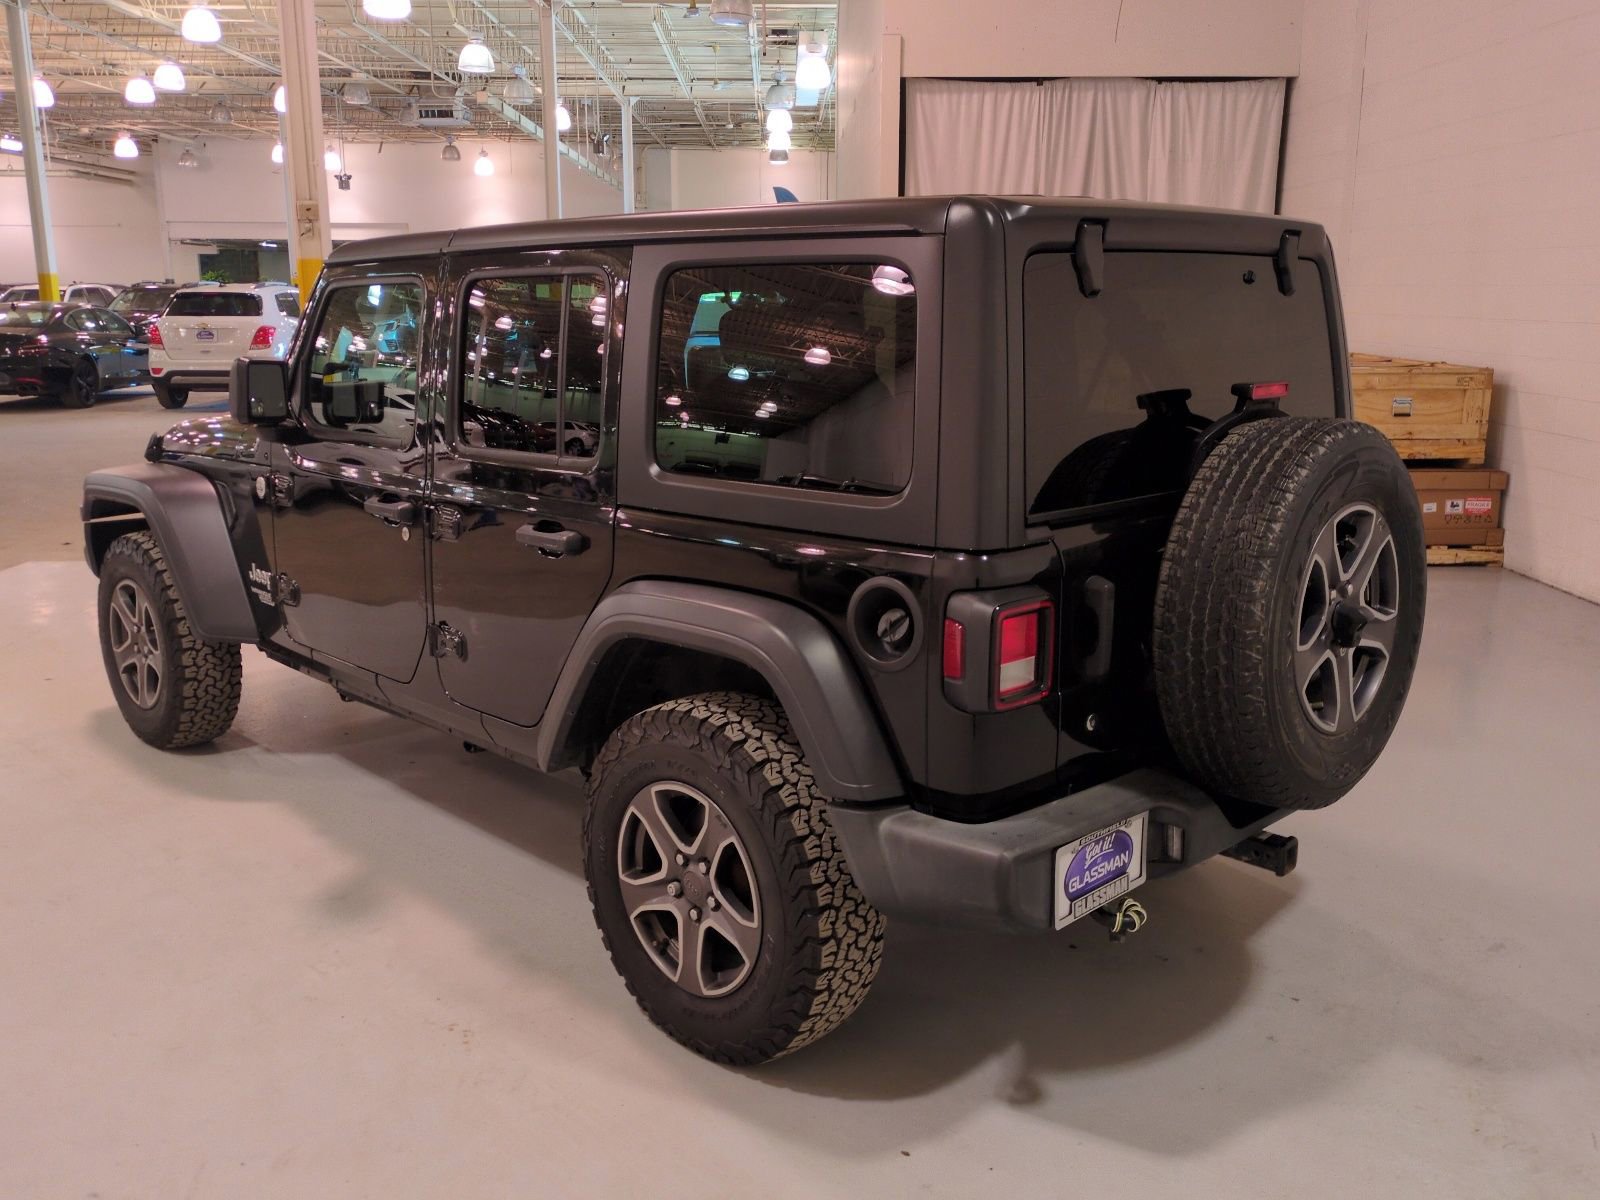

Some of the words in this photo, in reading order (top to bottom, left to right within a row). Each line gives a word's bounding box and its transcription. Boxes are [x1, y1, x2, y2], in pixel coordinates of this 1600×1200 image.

[249, 562, 271, 590] Jeep
[1085, 841, 1103, 863] Got
[1103, 832, 1116, 851] it!
[1068, 850, 1129, 893] GLASSMAN
[1075, 876, 1128, 917] GLASSMAN
